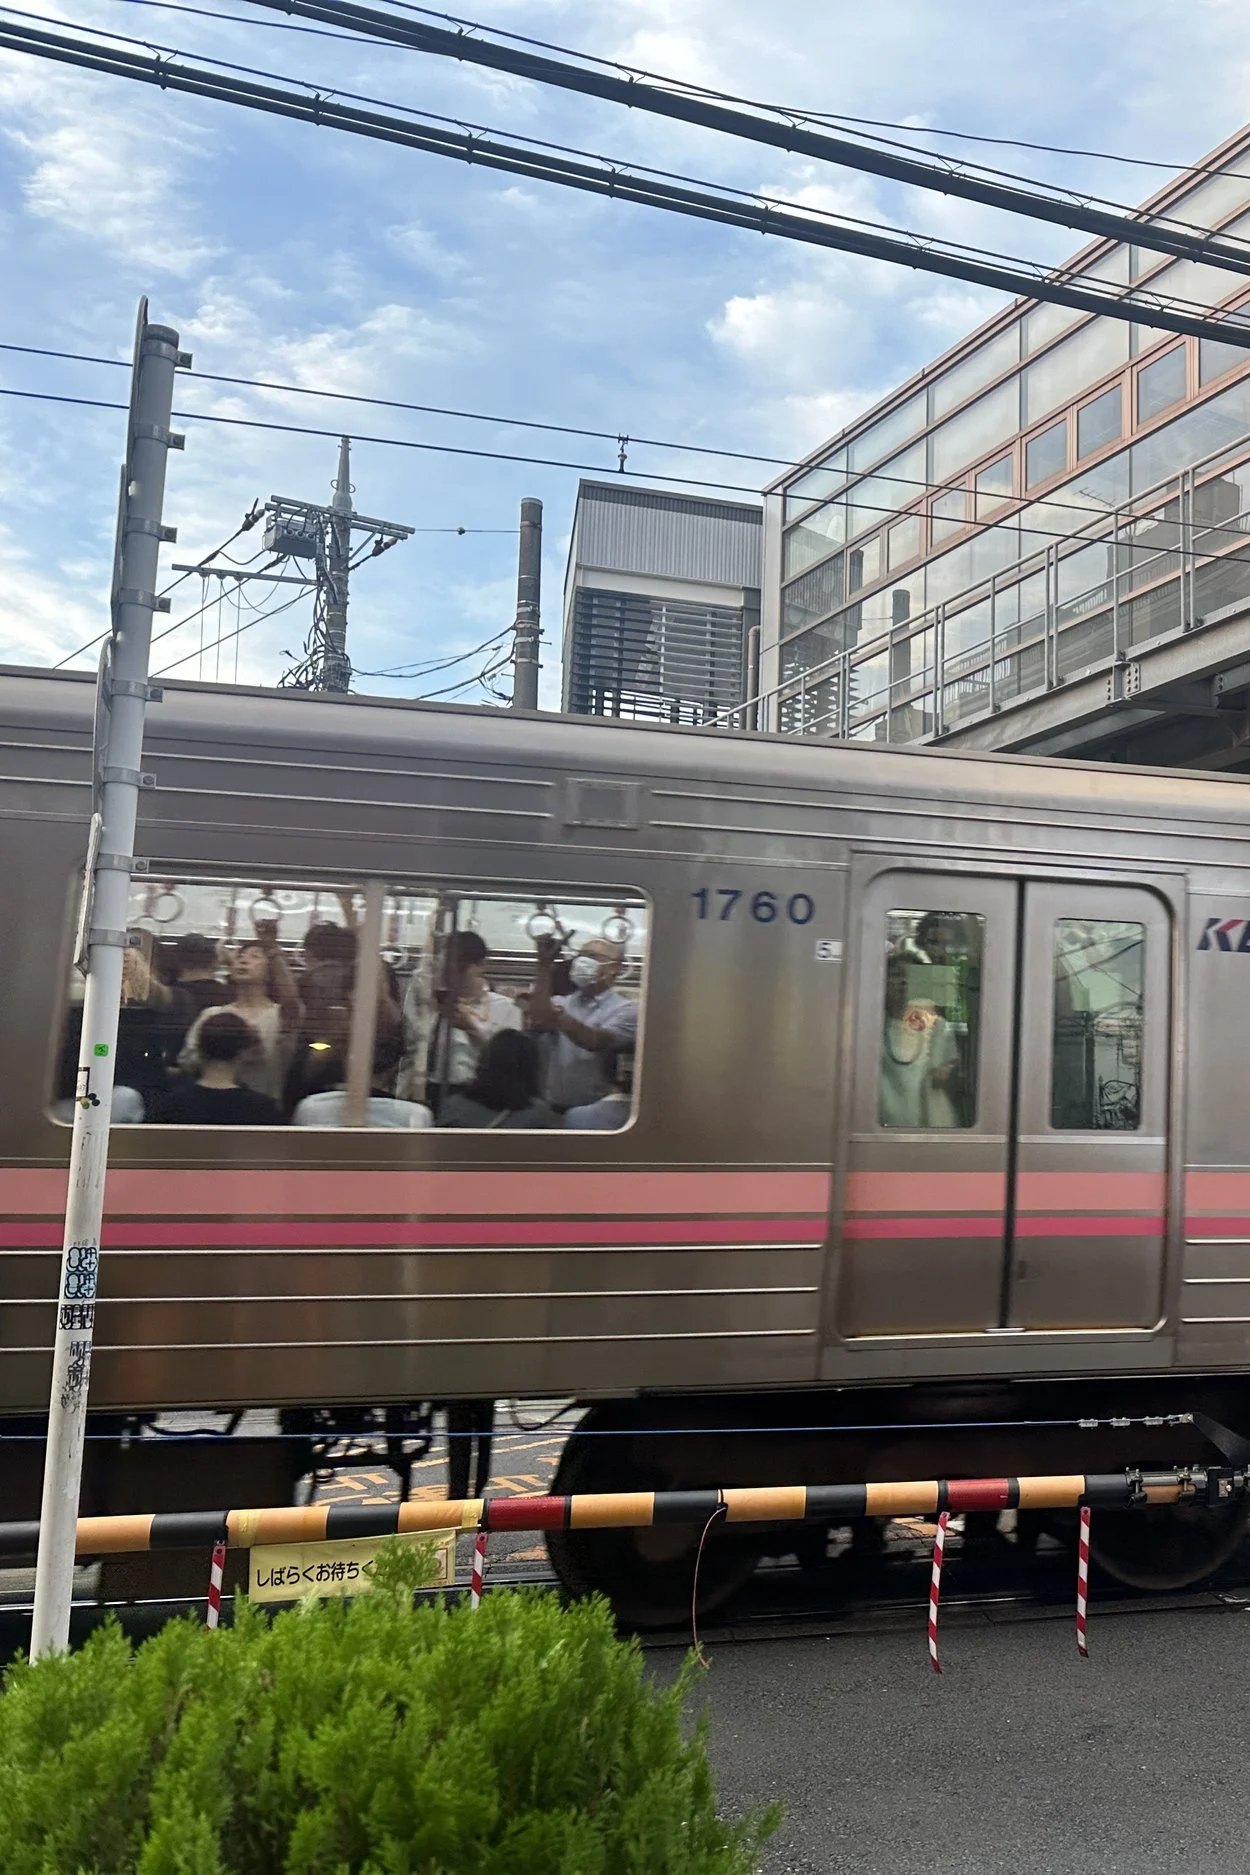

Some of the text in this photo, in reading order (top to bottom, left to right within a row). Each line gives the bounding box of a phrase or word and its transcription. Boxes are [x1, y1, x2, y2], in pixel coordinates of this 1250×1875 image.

[691, 888, 816, 925] 1760
[256, 1559, 375, 1588] しばらくお待ちく
